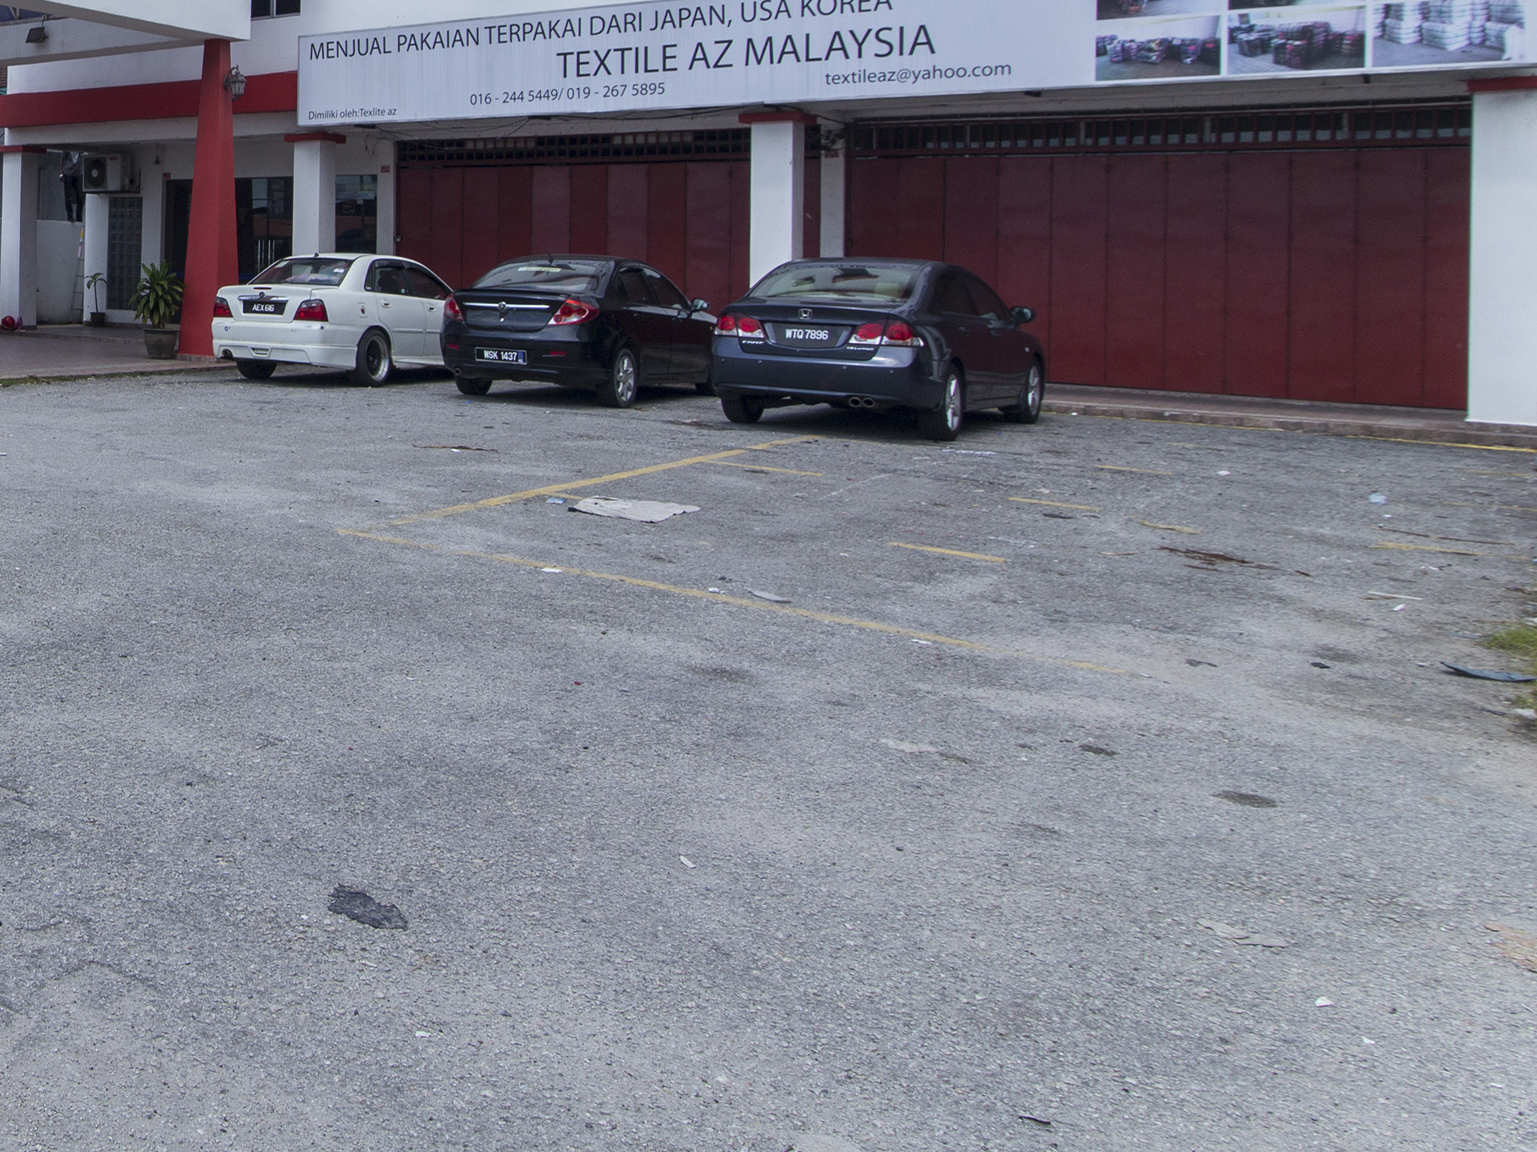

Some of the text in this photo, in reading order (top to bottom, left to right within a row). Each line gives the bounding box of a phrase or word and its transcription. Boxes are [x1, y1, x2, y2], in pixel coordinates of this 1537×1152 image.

[309, 36, 392, 61] MENJUAL
[397, 27, 479, 53] PAKAIAN
[484, 17, 582, 45] TERPAKAI
[590, 12, 642, 36] DARI
[650, 4, 733, 32] JAPAN,
[556, 24, 936, 79] TEXTILE AZ MALAYSIA
[825, 63, 1012, 86] textileaz@yahoo.com
[470, 92, 492, 106] 016
[502, 90, 525, 104] 244
[567, 86, 591, 100] 019
[603, 84, 627, 98] 267
[632, 82, 666, 97] 5895
[308, 110, 339, 120] Dimiliki
[387, 108, 397, 116] az
[785, 328, 829, 340] WTQ 7896
[483, 349, 518, 361] WSK 1437
